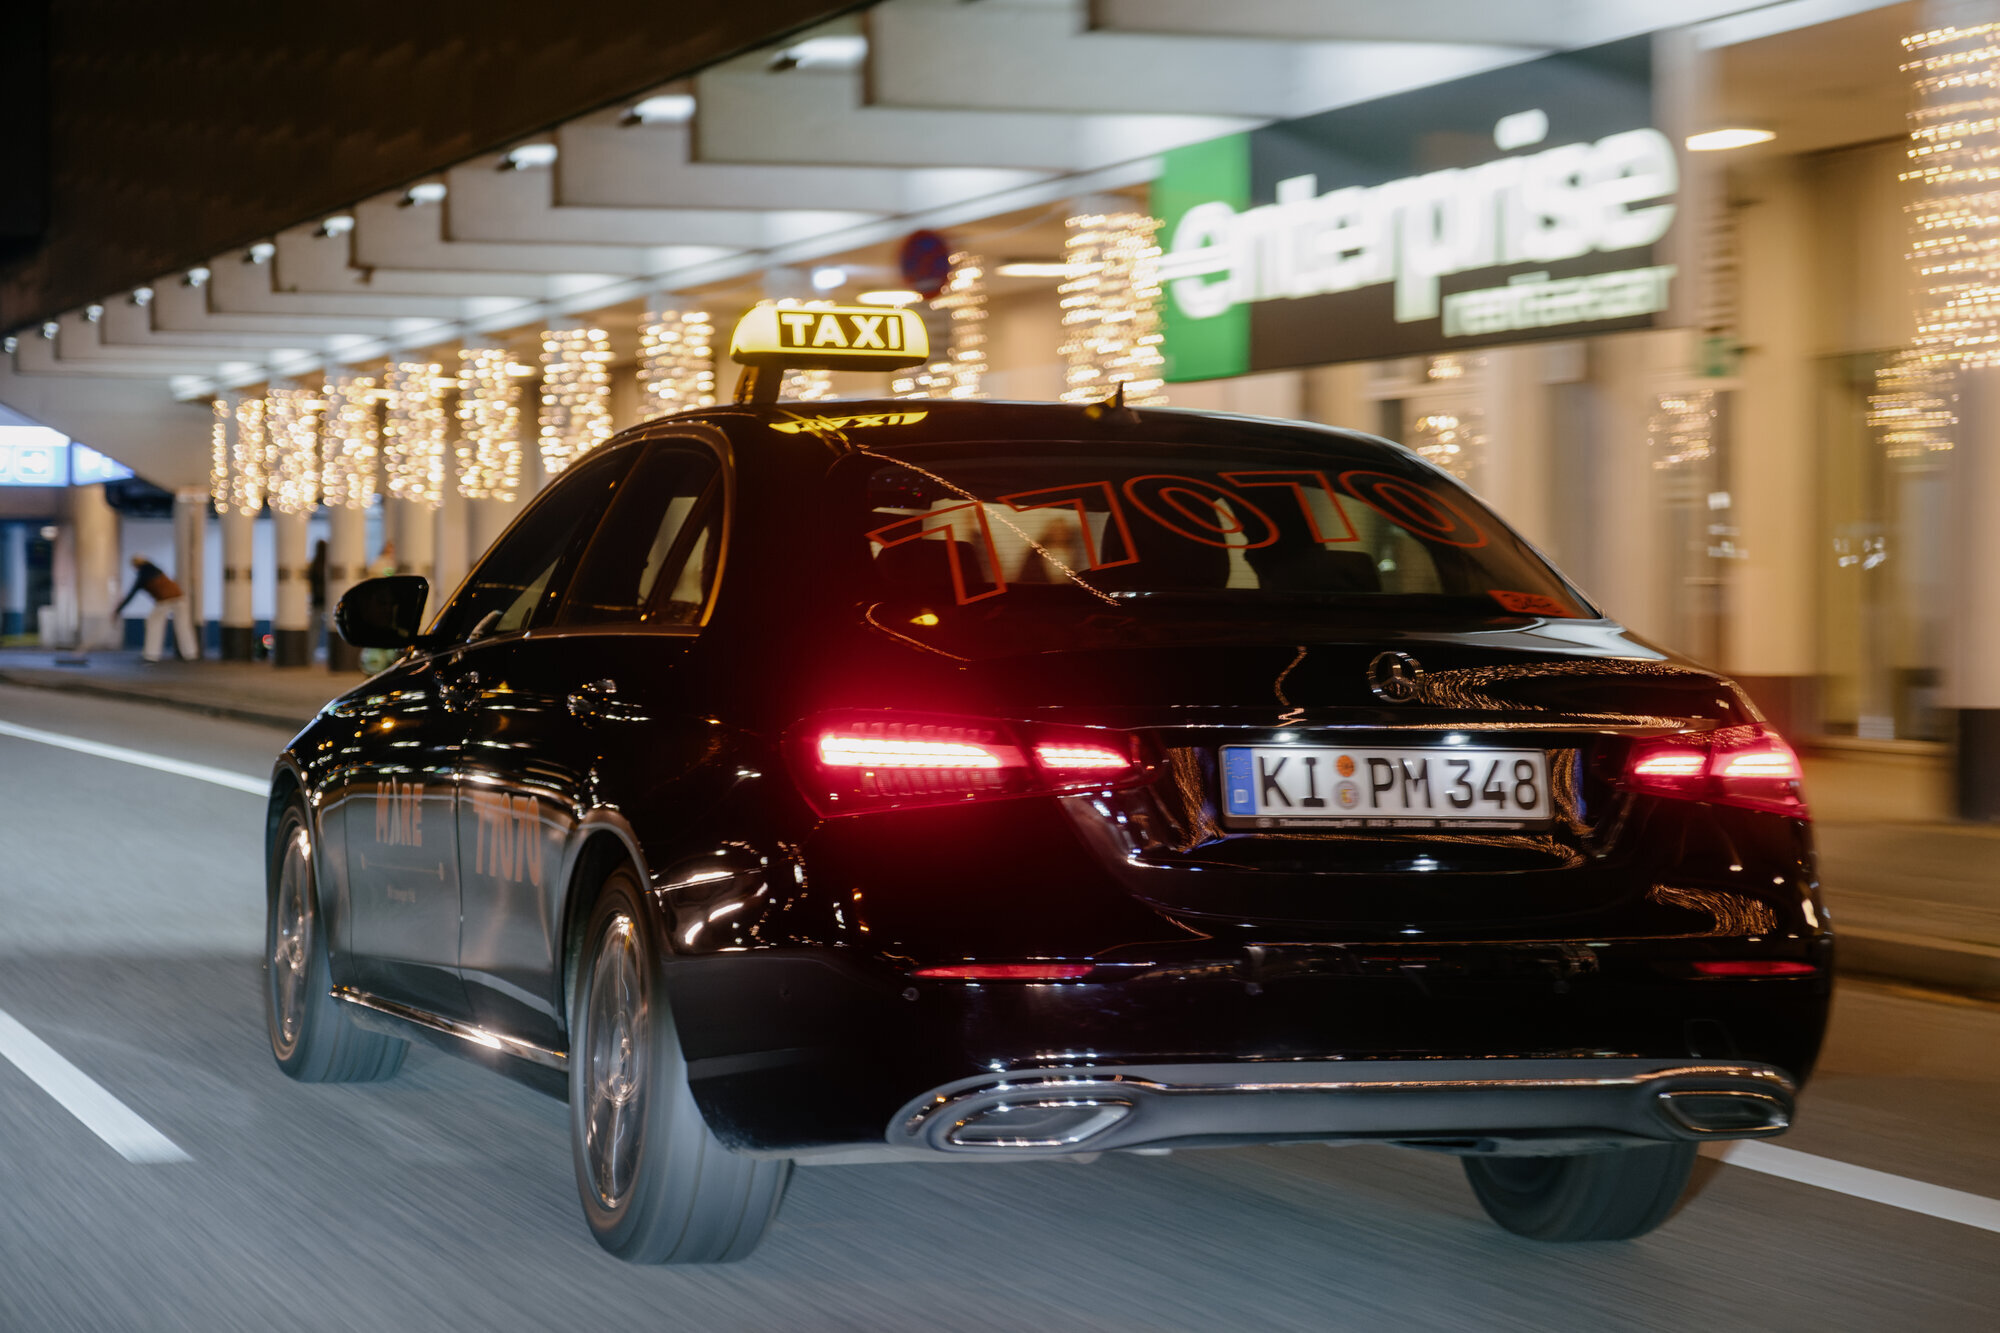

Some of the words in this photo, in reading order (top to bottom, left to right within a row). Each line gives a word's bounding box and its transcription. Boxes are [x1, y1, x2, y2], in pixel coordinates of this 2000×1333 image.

[1164, 108, 1678, 322] enterprise
[780, 313, 902, 348] TAXI
[865, 470, 1487, 605] 77070
[1259, 756, 1324, 808] KI
[1365, 757, 1432, 809] PM
[1446, 759, 1538, 811] 348
